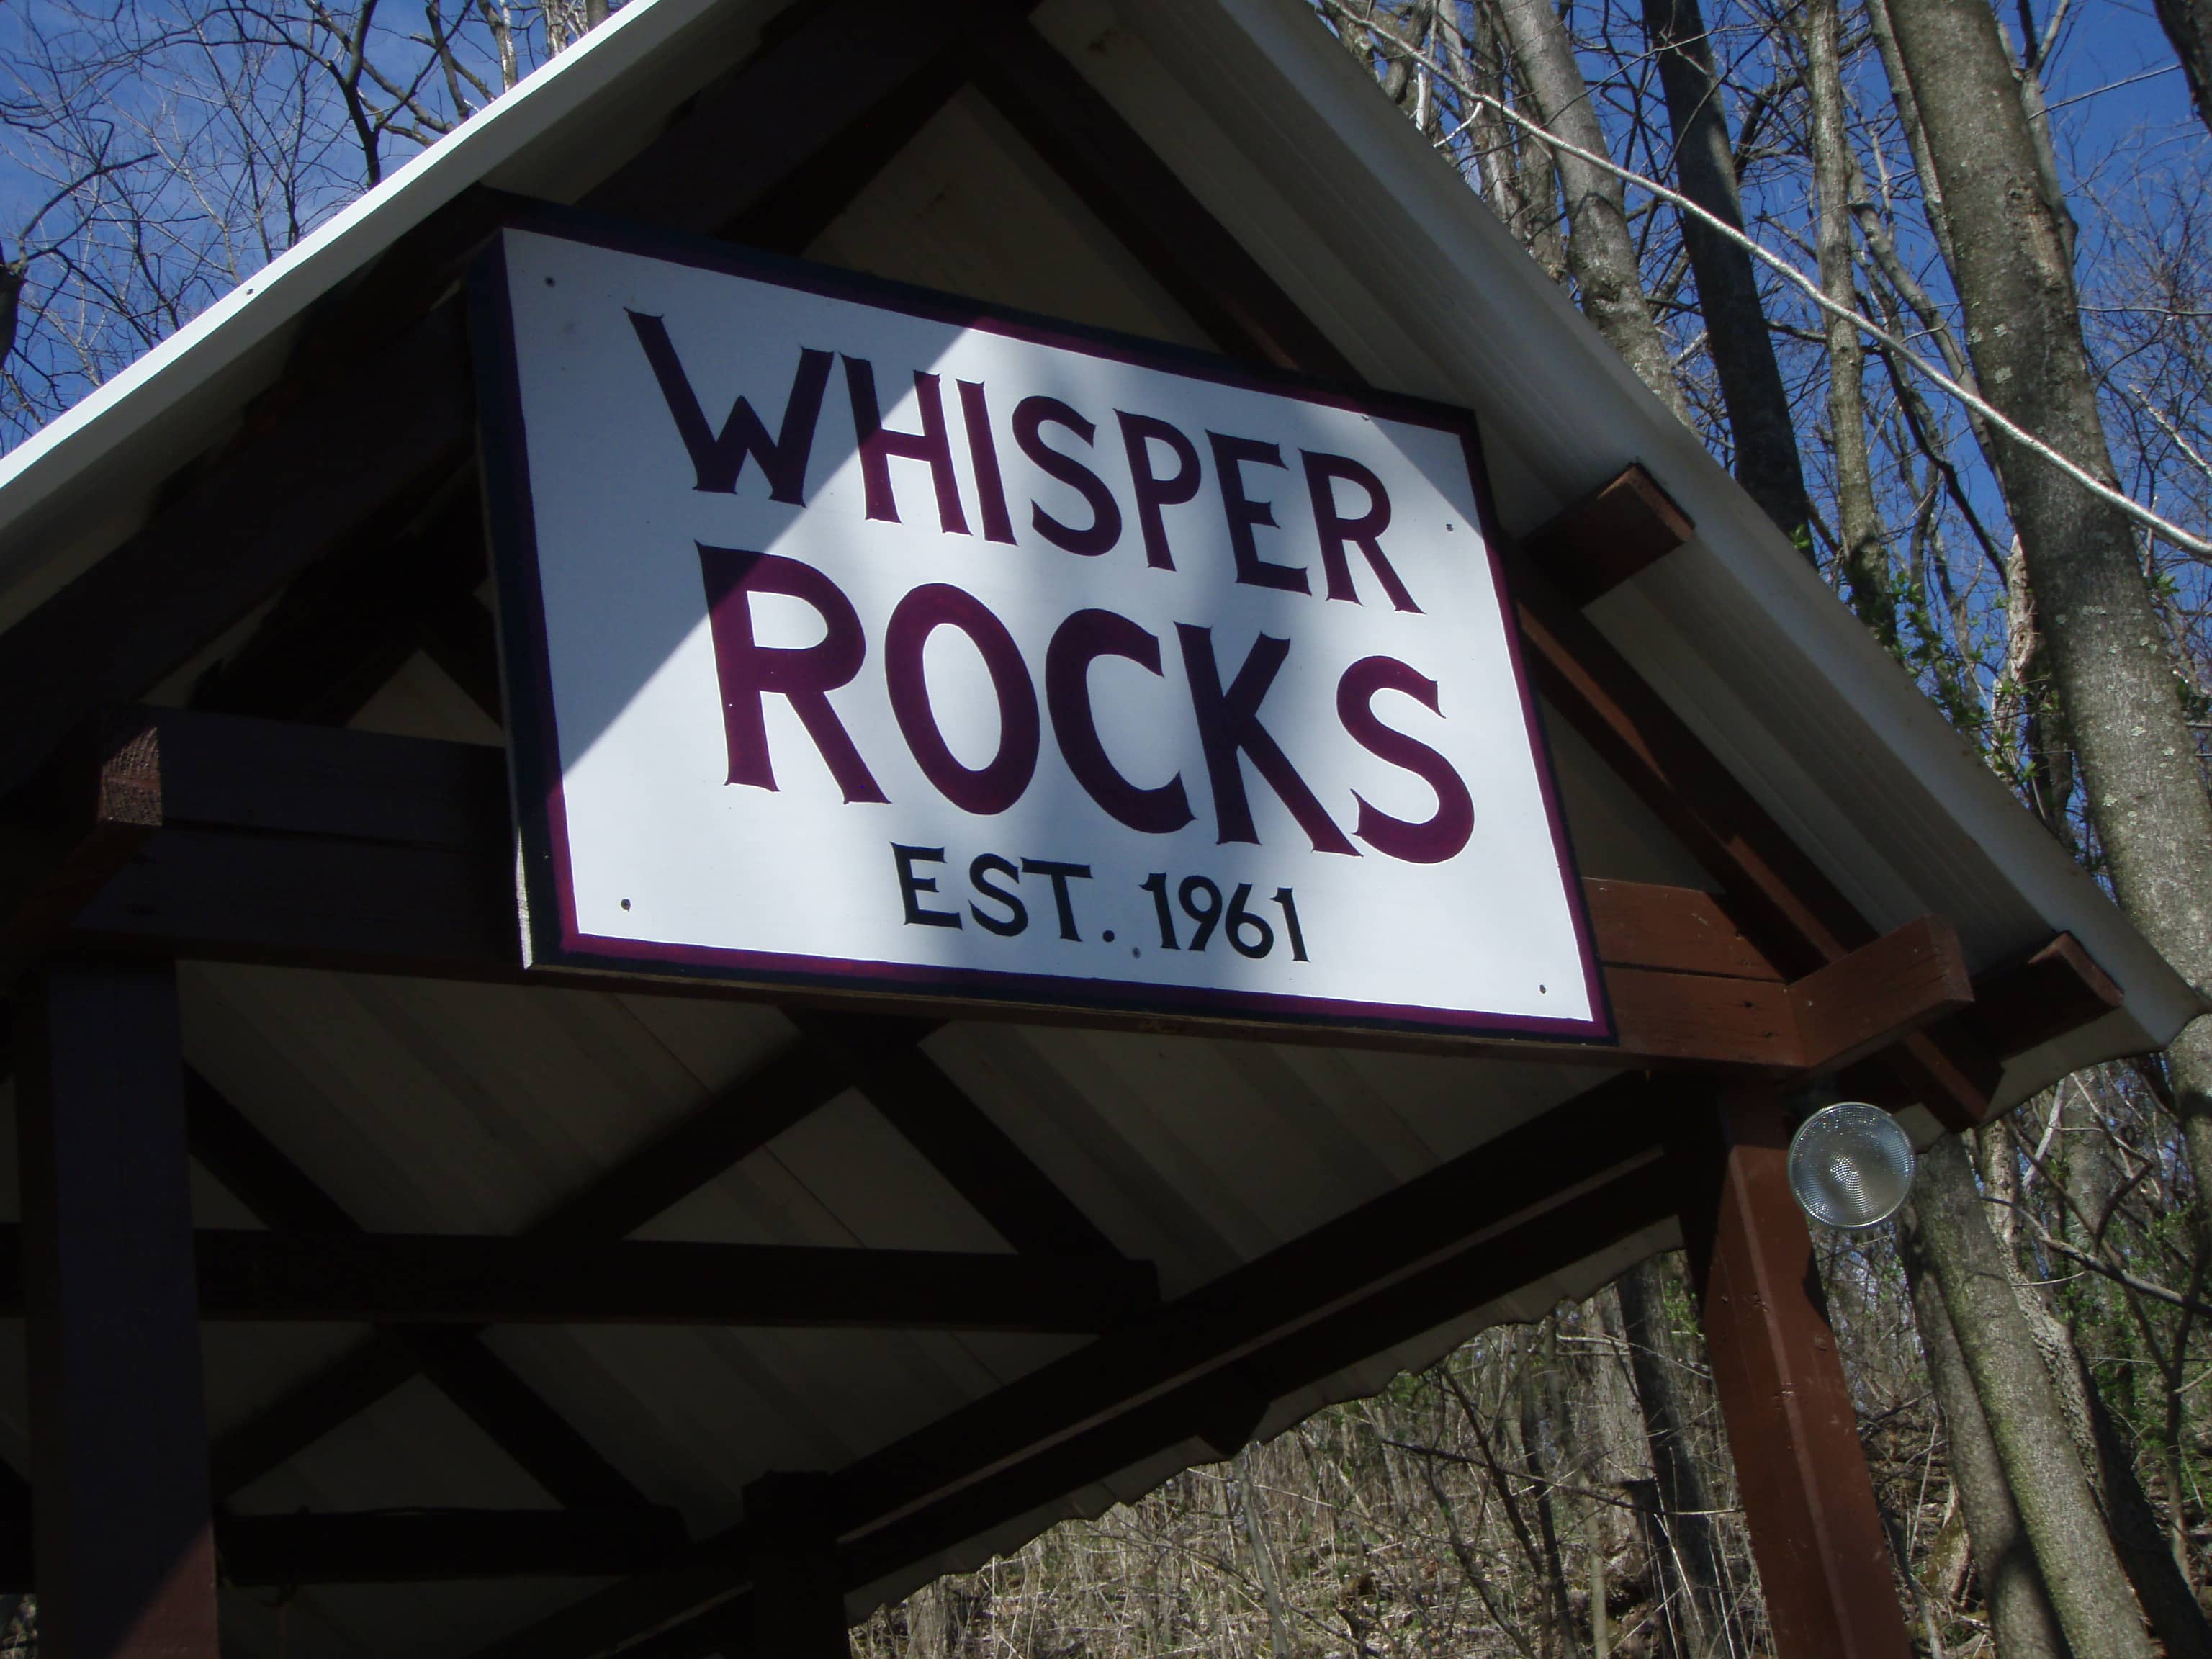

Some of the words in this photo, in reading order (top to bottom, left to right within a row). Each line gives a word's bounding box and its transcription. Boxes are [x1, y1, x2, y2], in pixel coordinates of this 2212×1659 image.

[624, 307, 1424, 614] WHISPER
[694, 541, 1474, 864] ROCKS
[890, 842, 1117, 944] EST.
[1137, 871, 1309, 962] 1961
